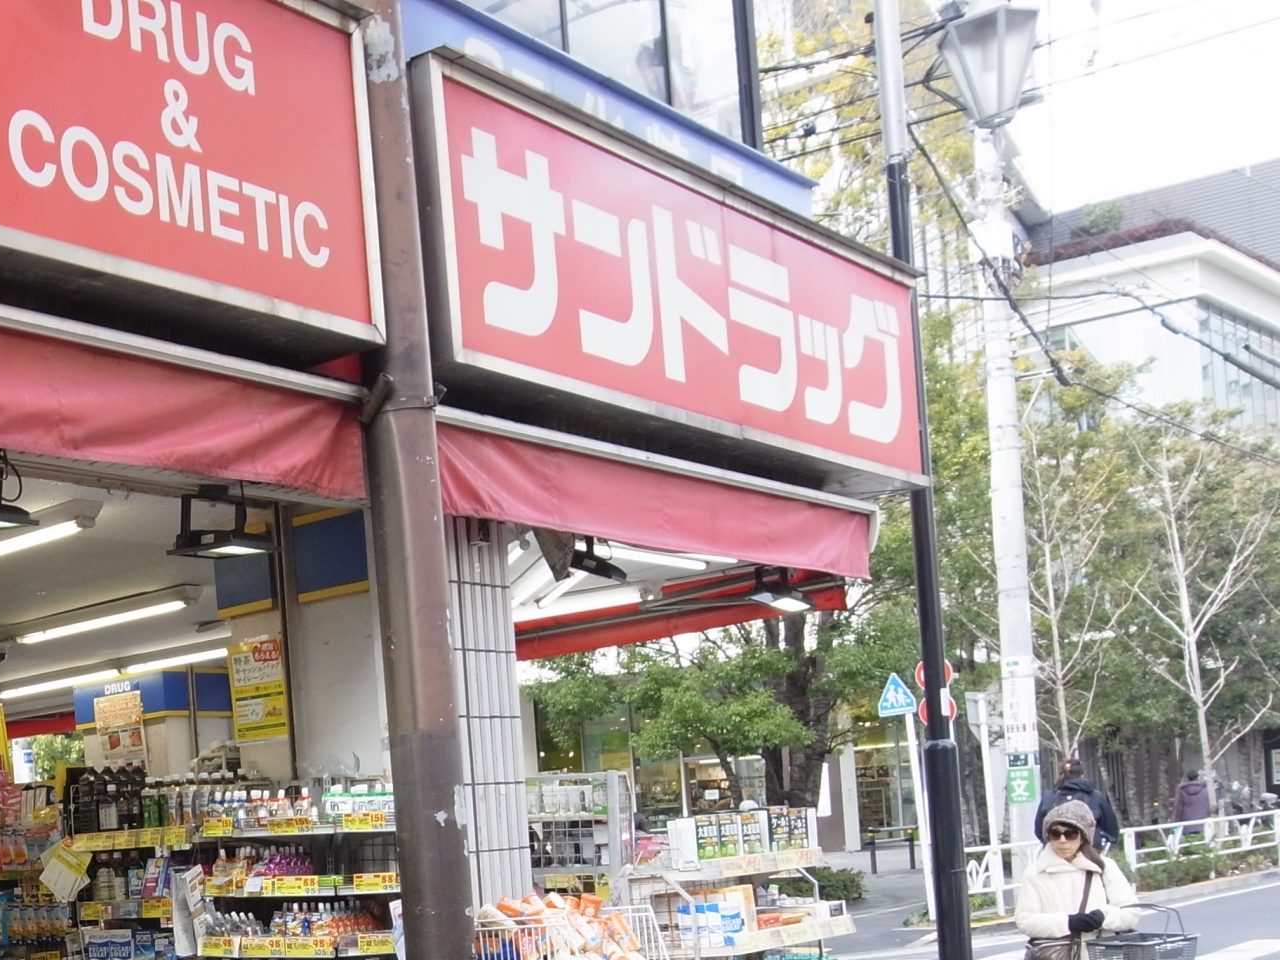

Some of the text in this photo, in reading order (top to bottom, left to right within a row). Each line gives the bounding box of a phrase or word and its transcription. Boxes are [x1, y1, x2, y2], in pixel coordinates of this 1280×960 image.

[81, 0, 255, 95] DRUG
[160, 78, 199, 153] &
[8, 108, 330, 268] COSMETIC
[460, 127, 900, 443] サンドラッグ
[104, 681, 131, 695] DRUG
[1010, 779, 1029, 797] 文
